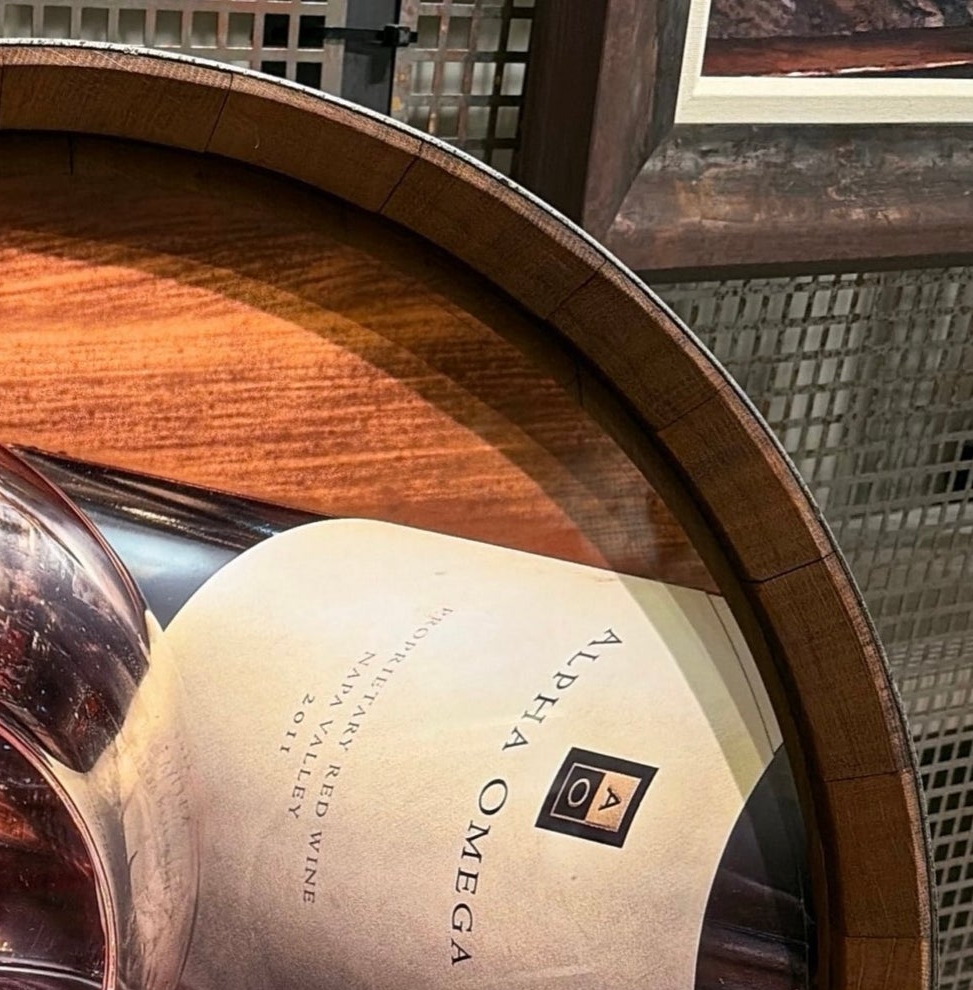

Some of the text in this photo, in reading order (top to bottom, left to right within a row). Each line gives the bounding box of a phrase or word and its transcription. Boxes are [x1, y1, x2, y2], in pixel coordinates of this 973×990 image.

[279, 693, 315, 752] 2011
[287, 651, 376, 819] NAPA VALLEY
[302, 607, 454, 904] PROPRIETARY RED WINE
[451, 628, 623, 966] ALPHA OMEGA
[598, 786, 622, 811] A
